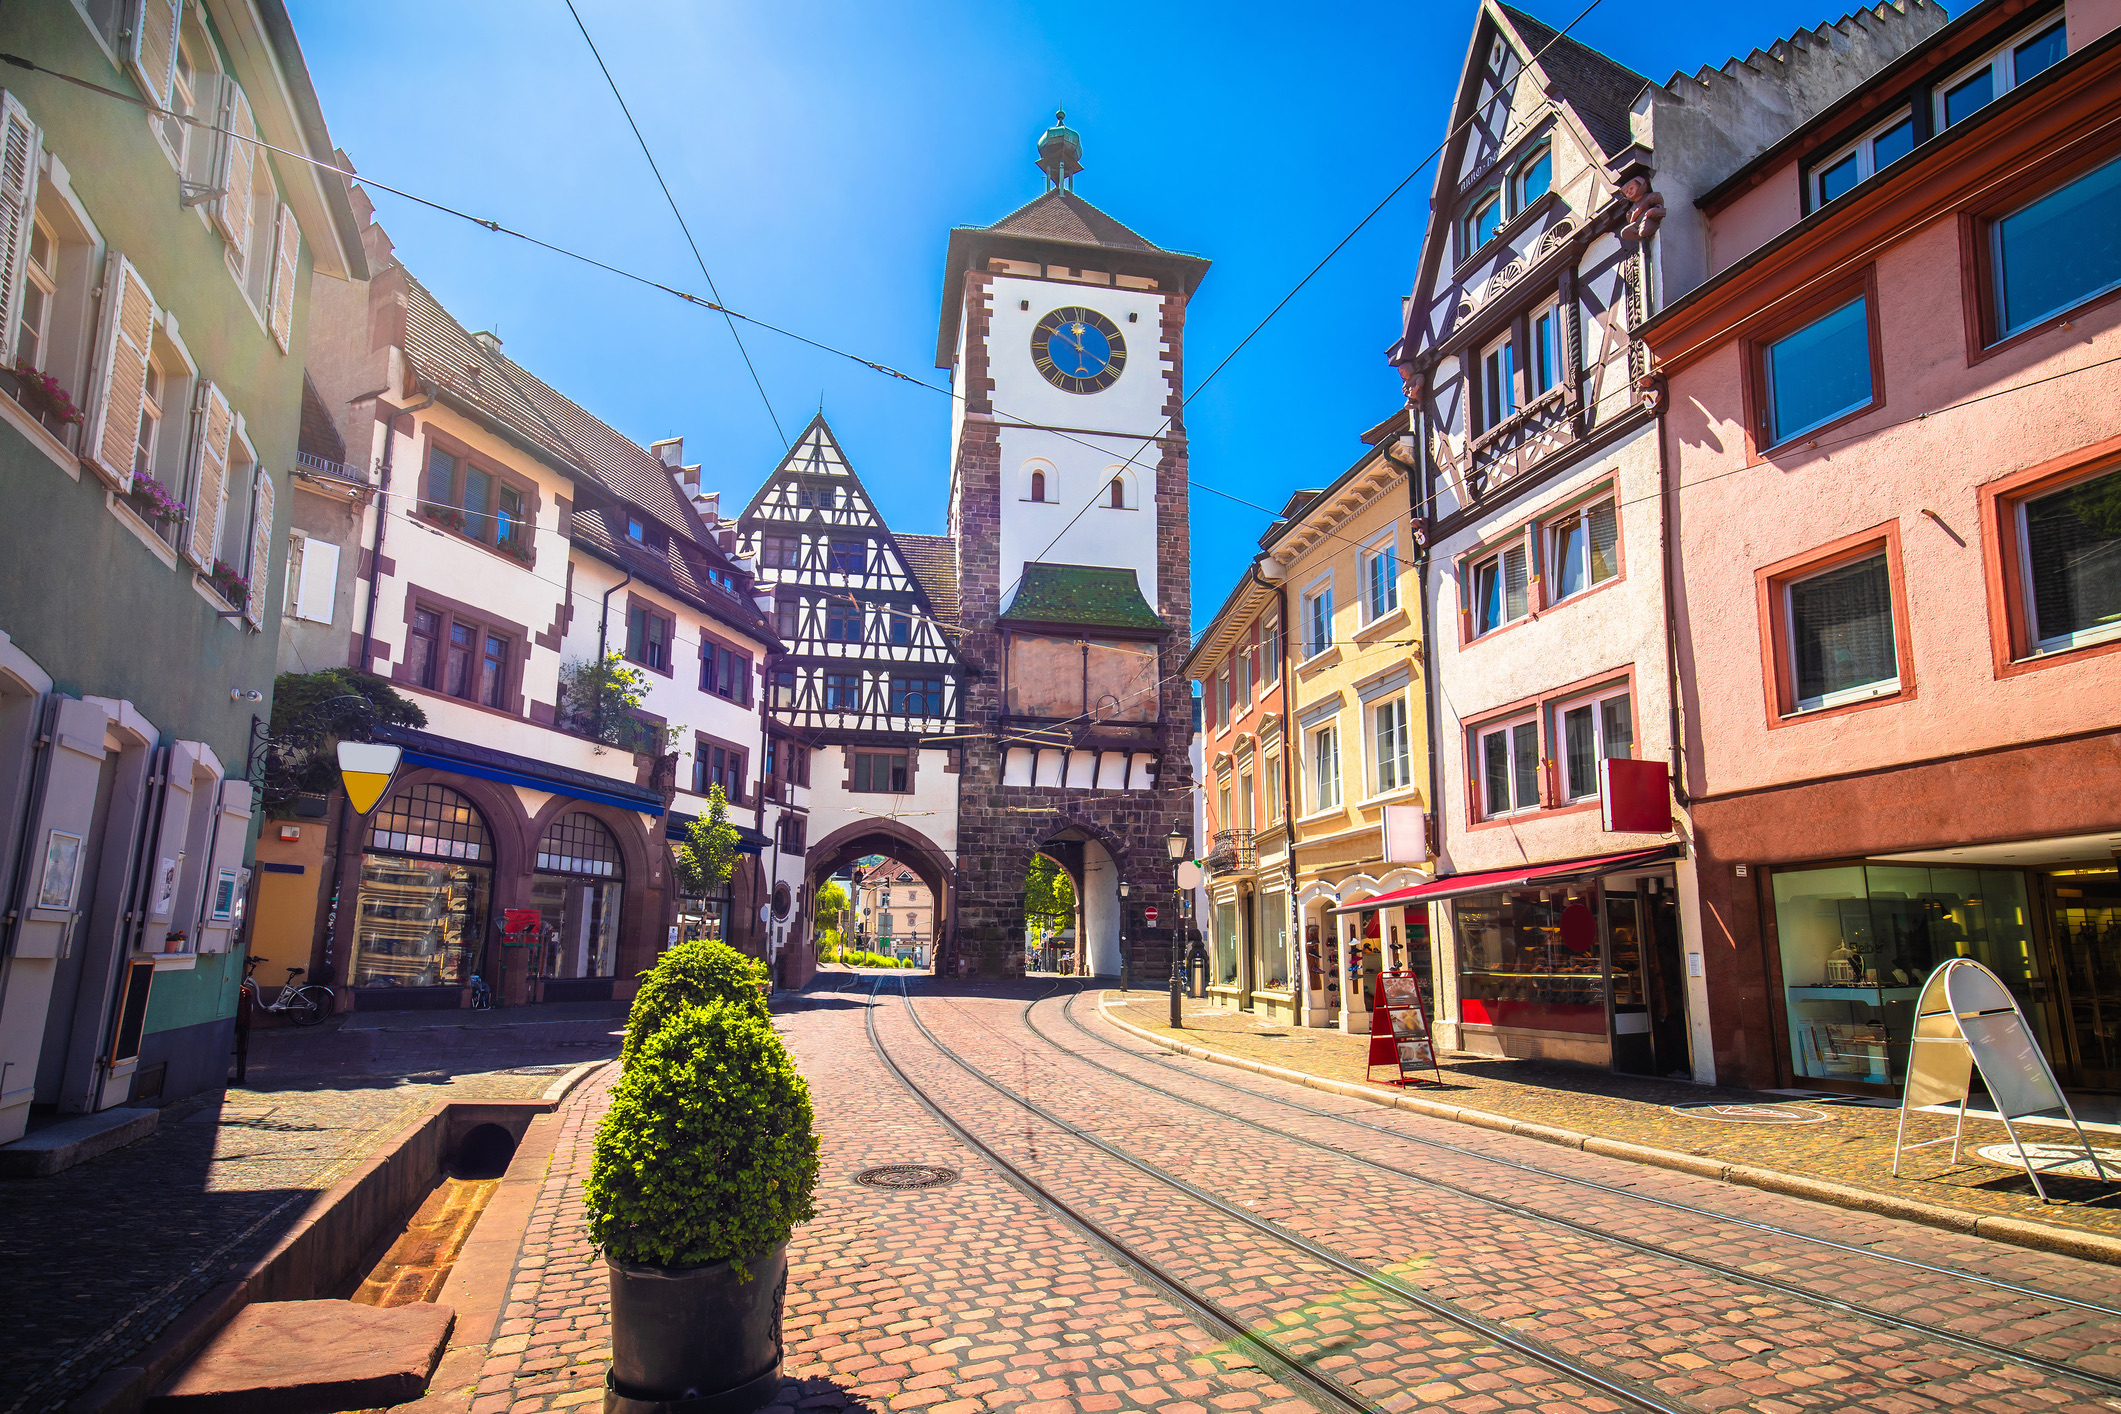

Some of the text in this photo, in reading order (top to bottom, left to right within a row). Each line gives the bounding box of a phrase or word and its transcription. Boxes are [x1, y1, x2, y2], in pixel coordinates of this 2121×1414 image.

[1052, 309, 1067, 323] XI
[1074, 307, 1085, 322] XII
[1106, 331, 1121, 340] II
[1032, 340, 1047, 349] IX
[1111, 350, 1126, 358] III
[1036, 357, 1052, 373] VIII
[1051, 370, 1066, 387] VII
[1075, 379, 1084, 393] VI
